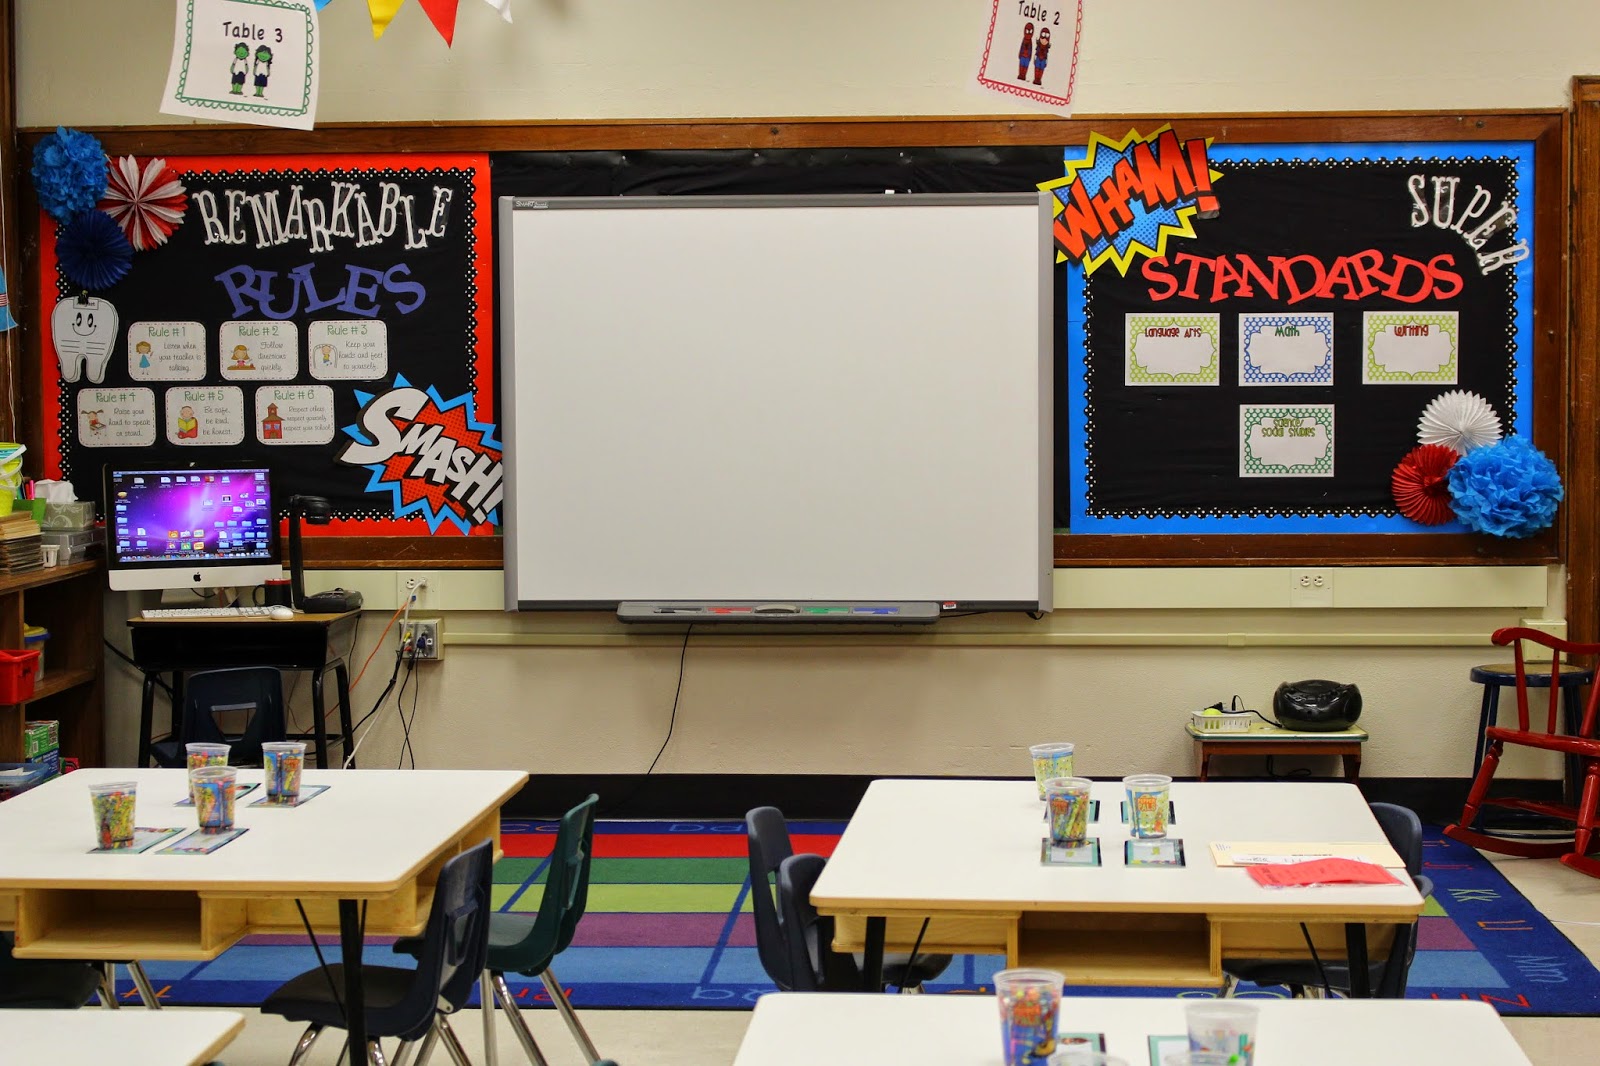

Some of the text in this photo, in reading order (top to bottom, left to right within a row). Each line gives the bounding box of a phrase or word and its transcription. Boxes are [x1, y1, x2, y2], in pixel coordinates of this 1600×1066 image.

[1018, 0, 1061, 26] Table 2
[222, 21, 283, 43] Table 3
[1053, 129, 1220, 262] WHAM!
[191, 180, 454, 254] REMARKABLE
[1406, 173, 1530, 276] SUPER
[1140, 247, 1465, 305] STANDARDS
[213, 261, 427, 320] RULES
[148, 326, 170, 338] Rule
[238, 326, 260, 337] Rule
[326, 324, 348, 336] Rule
[1144, 327, 1180, 338] Language
[1274, 326, 1300, 338] Math
[163, 341, 196, 350] Listen when
[260, 341, 284, 350] Follow
[345, 340, 376, 350] Keep your
[158, 354, 172, 362] your
[173, 352, 195, 361] teacher
[258, 352, 287, 360] directions
[338, 351, 383, 360] hands and feet
[343, 362, 350, 370] to
[96, 392, 118, 404] Rule
[184, 390, 206, 402] Rule
[274, 390, 296, 401] Rule
[113, 407, 145, 417] Raise your
[204, 405, 214, 414] Be
[288, 405, 308, 414] Respect
[108, 418, 123, 426] hand
[132, 419, 152, 428] speak
[205, 417, 214, 425] be
[202, 428, 211, 436] be
[337, 387, 503, 525] SMASH!
